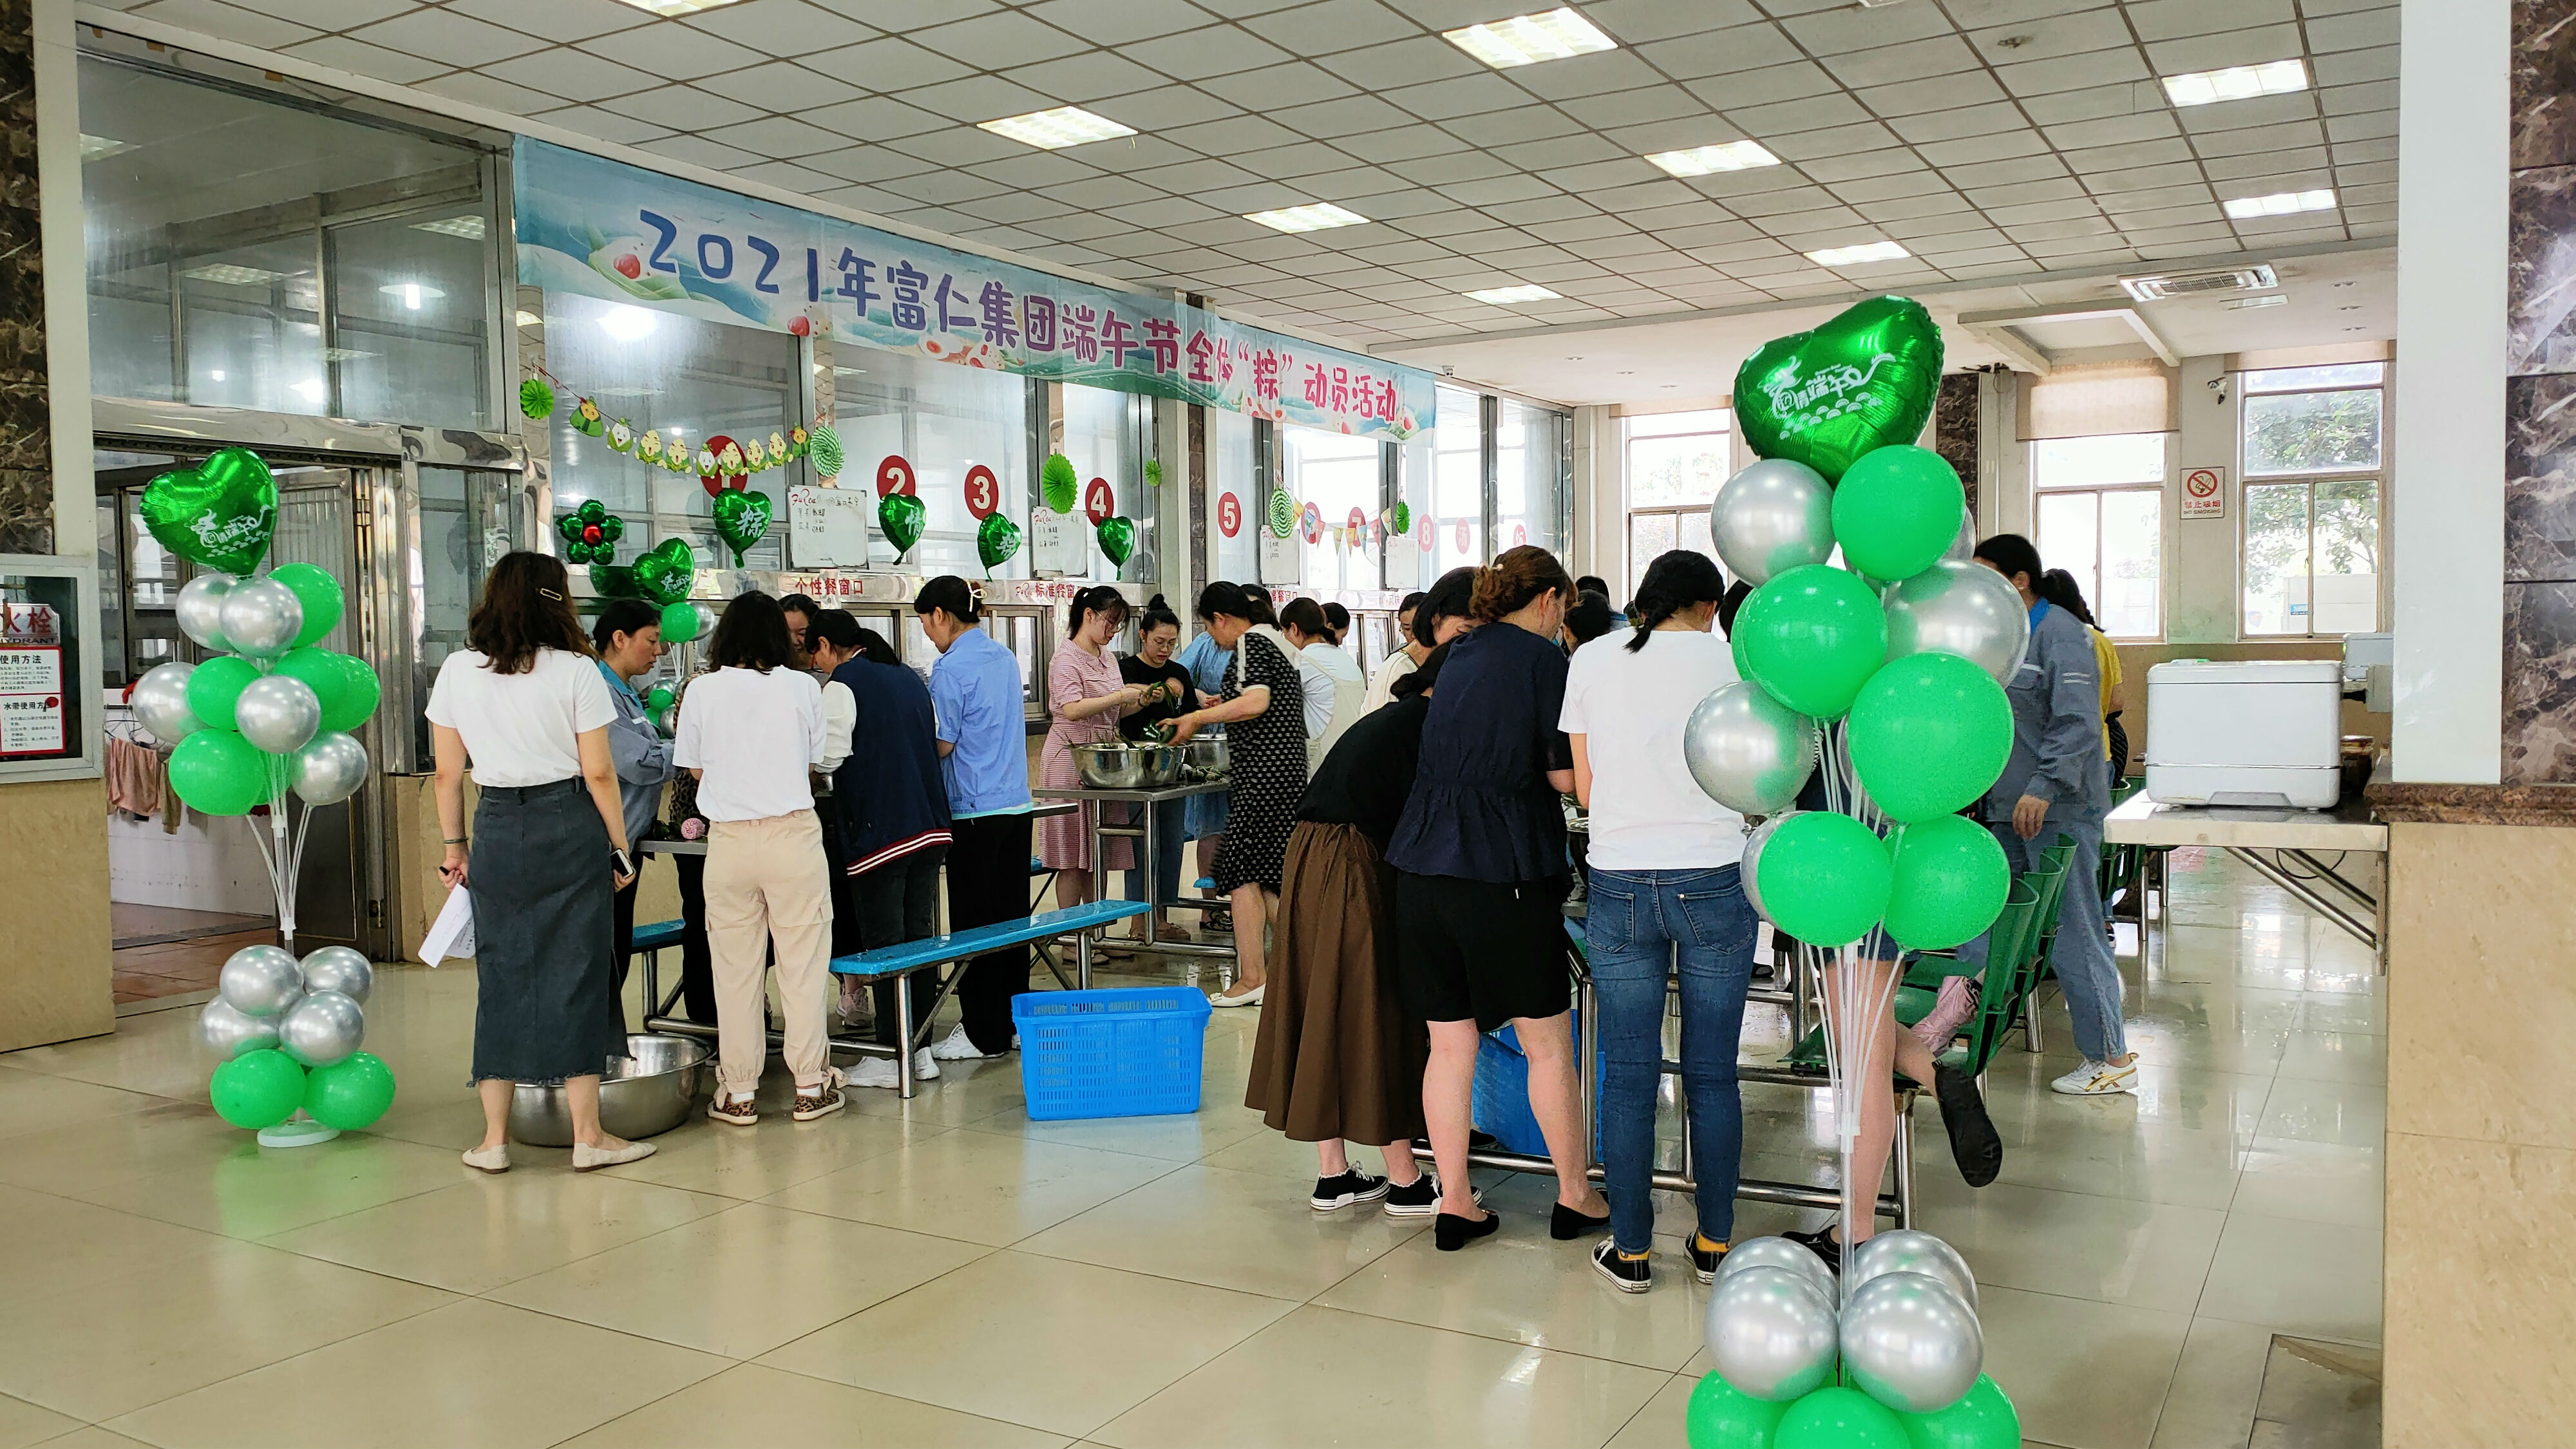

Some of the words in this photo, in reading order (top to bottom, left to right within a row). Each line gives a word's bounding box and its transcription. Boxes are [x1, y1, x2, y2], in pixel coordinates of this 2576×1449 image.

[887, 467, 906, 497] 2
[973, 475, 990, 509] 3
[1091, 486, 1107, 517] 4
[1224, 501, 1236, 529] 5
[736, 504, 766, 538] 粽
[1422, 522, 1431, 545] 8
[795, 577, 863, 596] 个性餐窗口
[0, 655, 42, 665] 使用方法
[4, 701, 52, 710] 水带使用方
